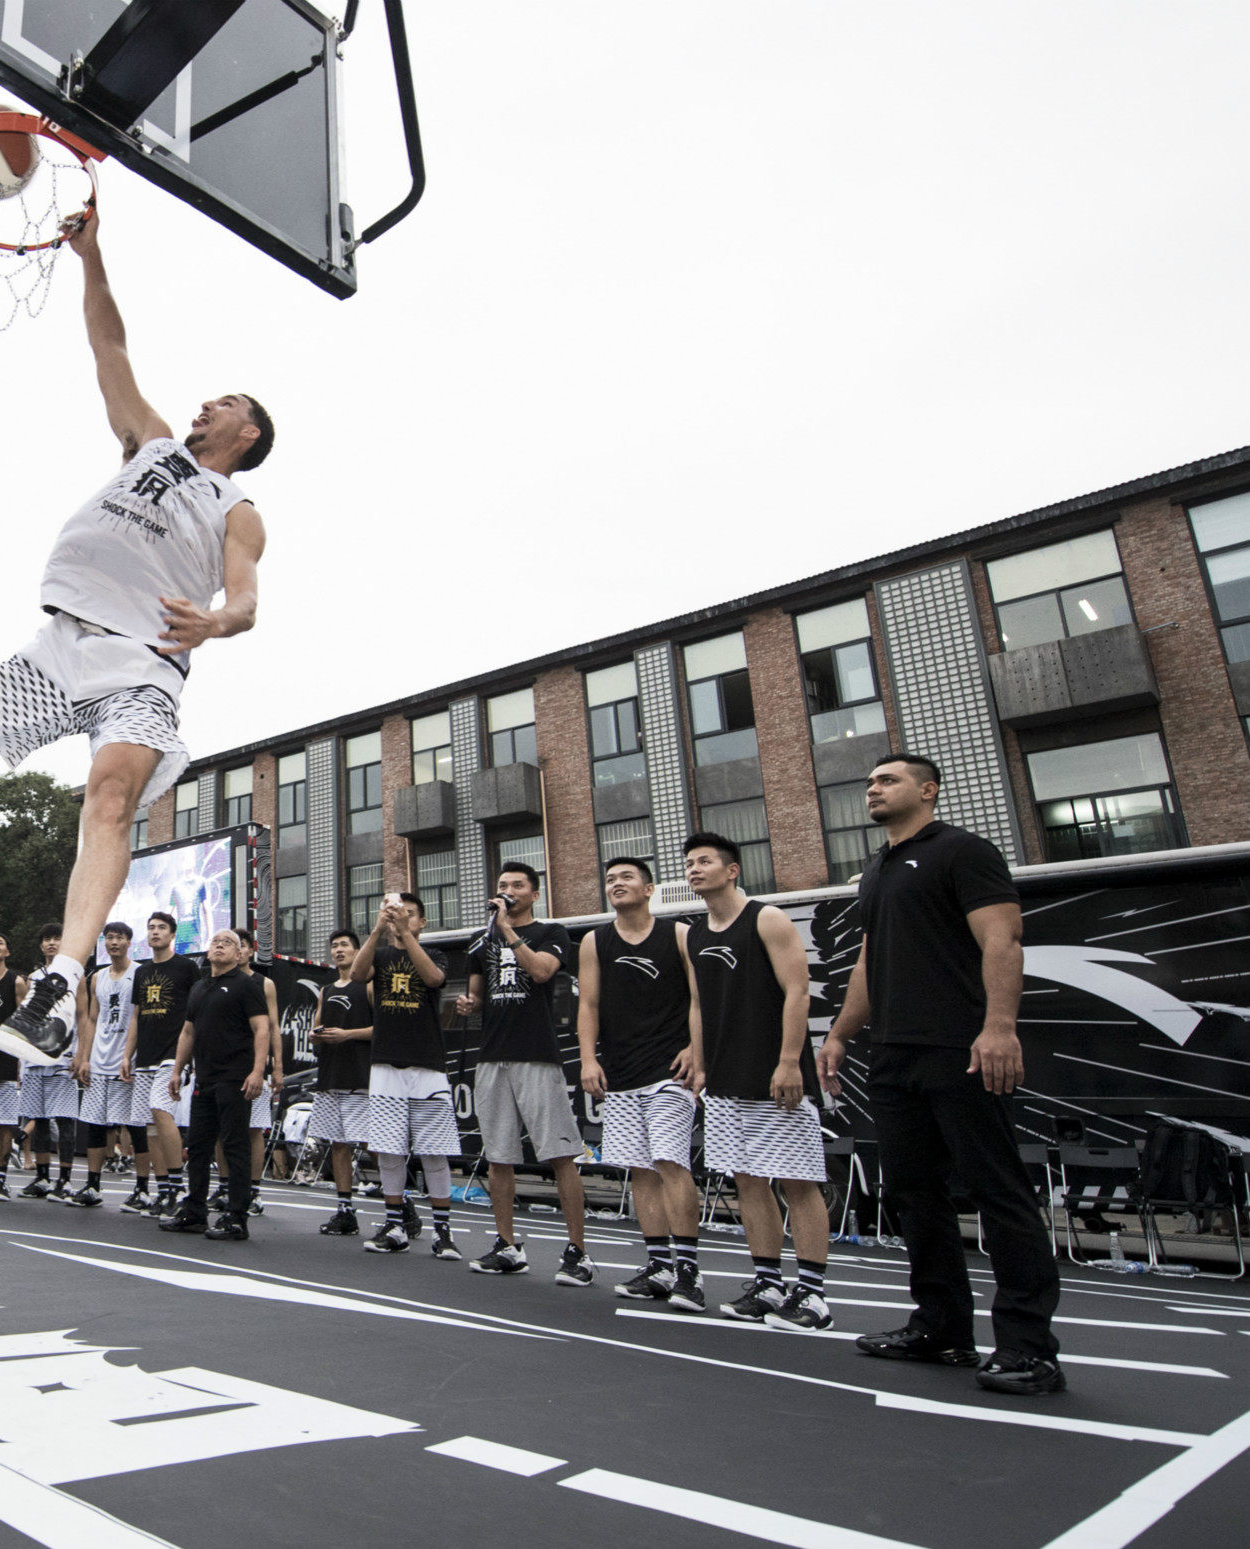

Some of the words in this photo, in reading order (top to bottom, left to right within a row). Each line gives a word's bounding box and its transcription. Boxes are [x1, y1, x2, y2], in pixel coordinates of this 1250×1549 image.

[101, 500, 128, 518] SHOCK
[127, 511, 144, 525] THE
[144, 519, 168, 539] GAME
